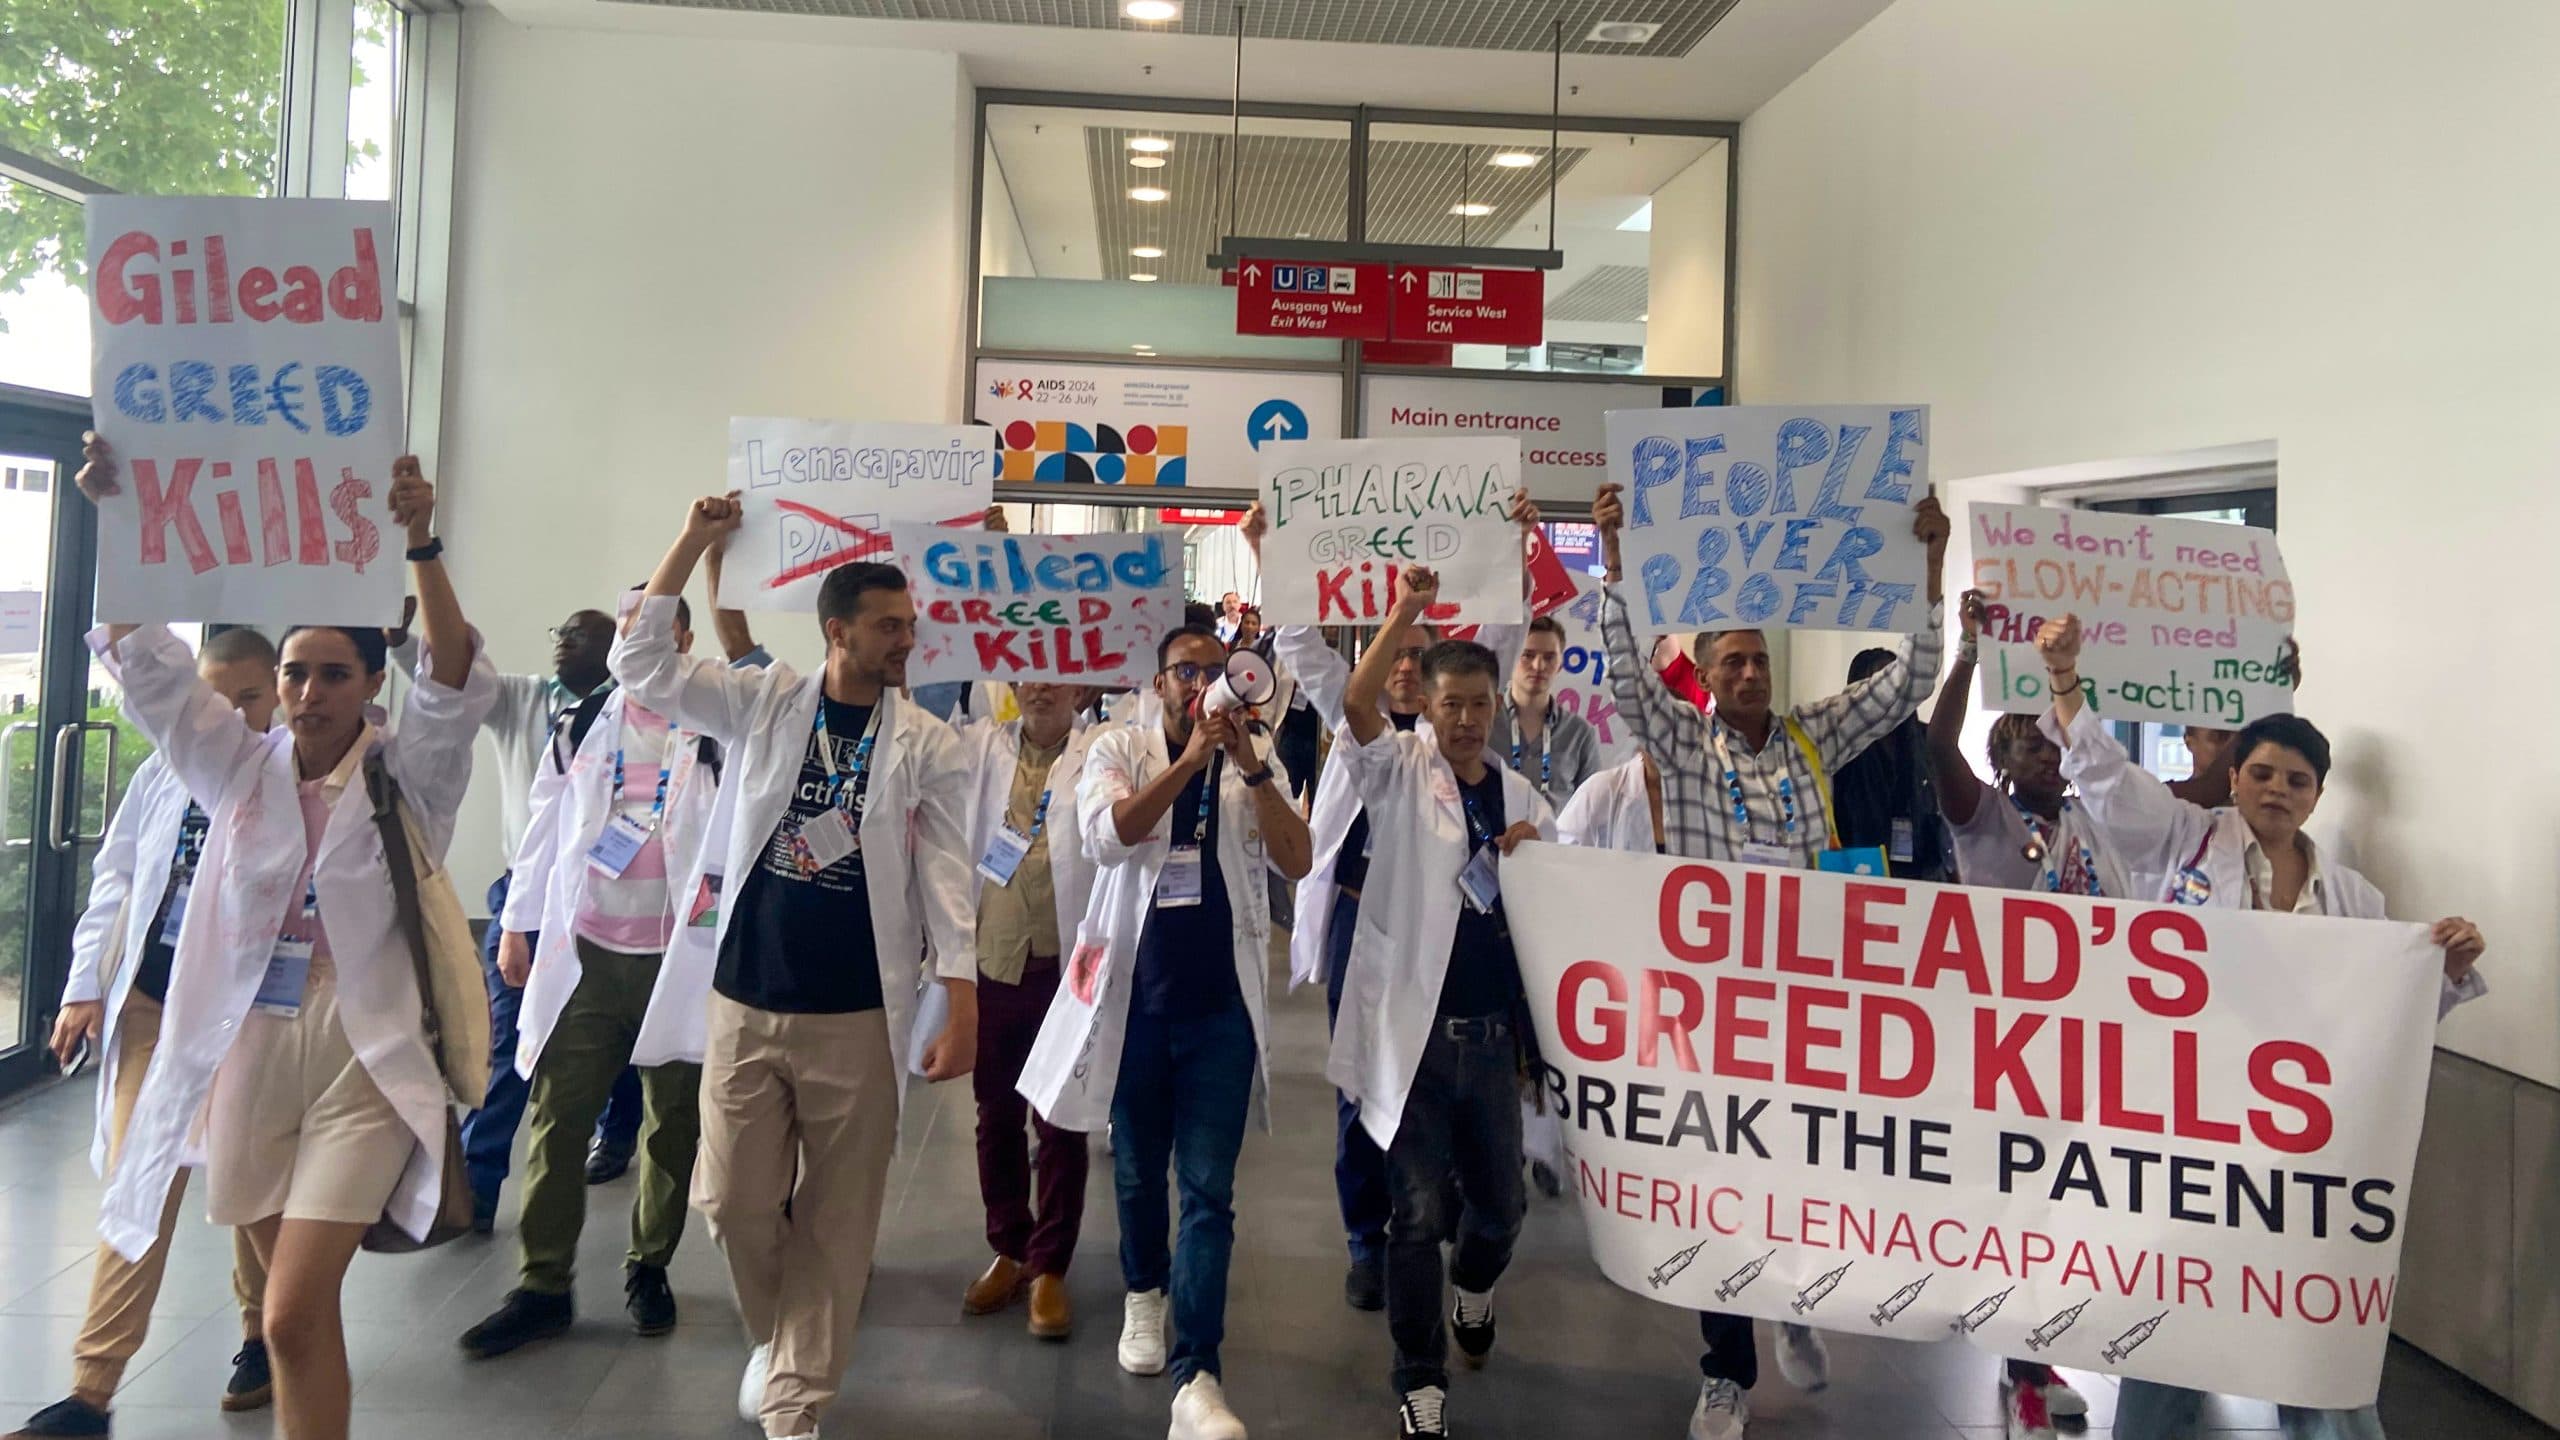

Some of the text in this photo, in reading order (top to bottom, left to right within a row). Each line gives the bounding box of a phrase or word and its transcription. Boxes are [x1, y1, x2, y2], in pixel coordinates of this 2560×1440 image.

[96, 227, 384, 325] Gilead
[1271, 299, 1363, 314] Ausgang West
[1278, 269, 1320, 289] U P
[1270, 315, 1327, 329] Exit West
[1427, 321, 1453, 334] ICM
[1428, 304, 1507, 319] Service West
[1037, 380, 1096, 392] AIDS 2024
[1074, 394, 1098, 407] July
[1391, 407, 1561, 432] Main entrance
[747, 438, 985, 488] Lenacapavir
[1529, 449, 1607, 466] access
[1630, 409, 1923, 529] PEOPLE
[1272, 462, 1514, 528] PHARMA
[780, 512, 896, 579] PATE
[922, 532, 1169, 595] Gilead
[1697, 517, 1885, 582] OVER
[1979, 512, 2264, 576] We don't need
[1641, 552, 1916, 629] PROFIT
[1974, 559, 2296, 624] SLOW-ACTING
[2081, 620, 2128, 646] we
[2152, 619, 2237, 648] need
[2000, 648, 2244, 724] log-acting
[1659, 864, 2209, 1018] GILEAD’S
[1557, 960, 2333, 1154] GREED KILLS
[1791, 1102, 1952, 1185] THE
[1999, 1131, 2396, 1244] PATENTS
[1564, 1148, 2395, 1326] NERIC LENACAPAVIR NOW
